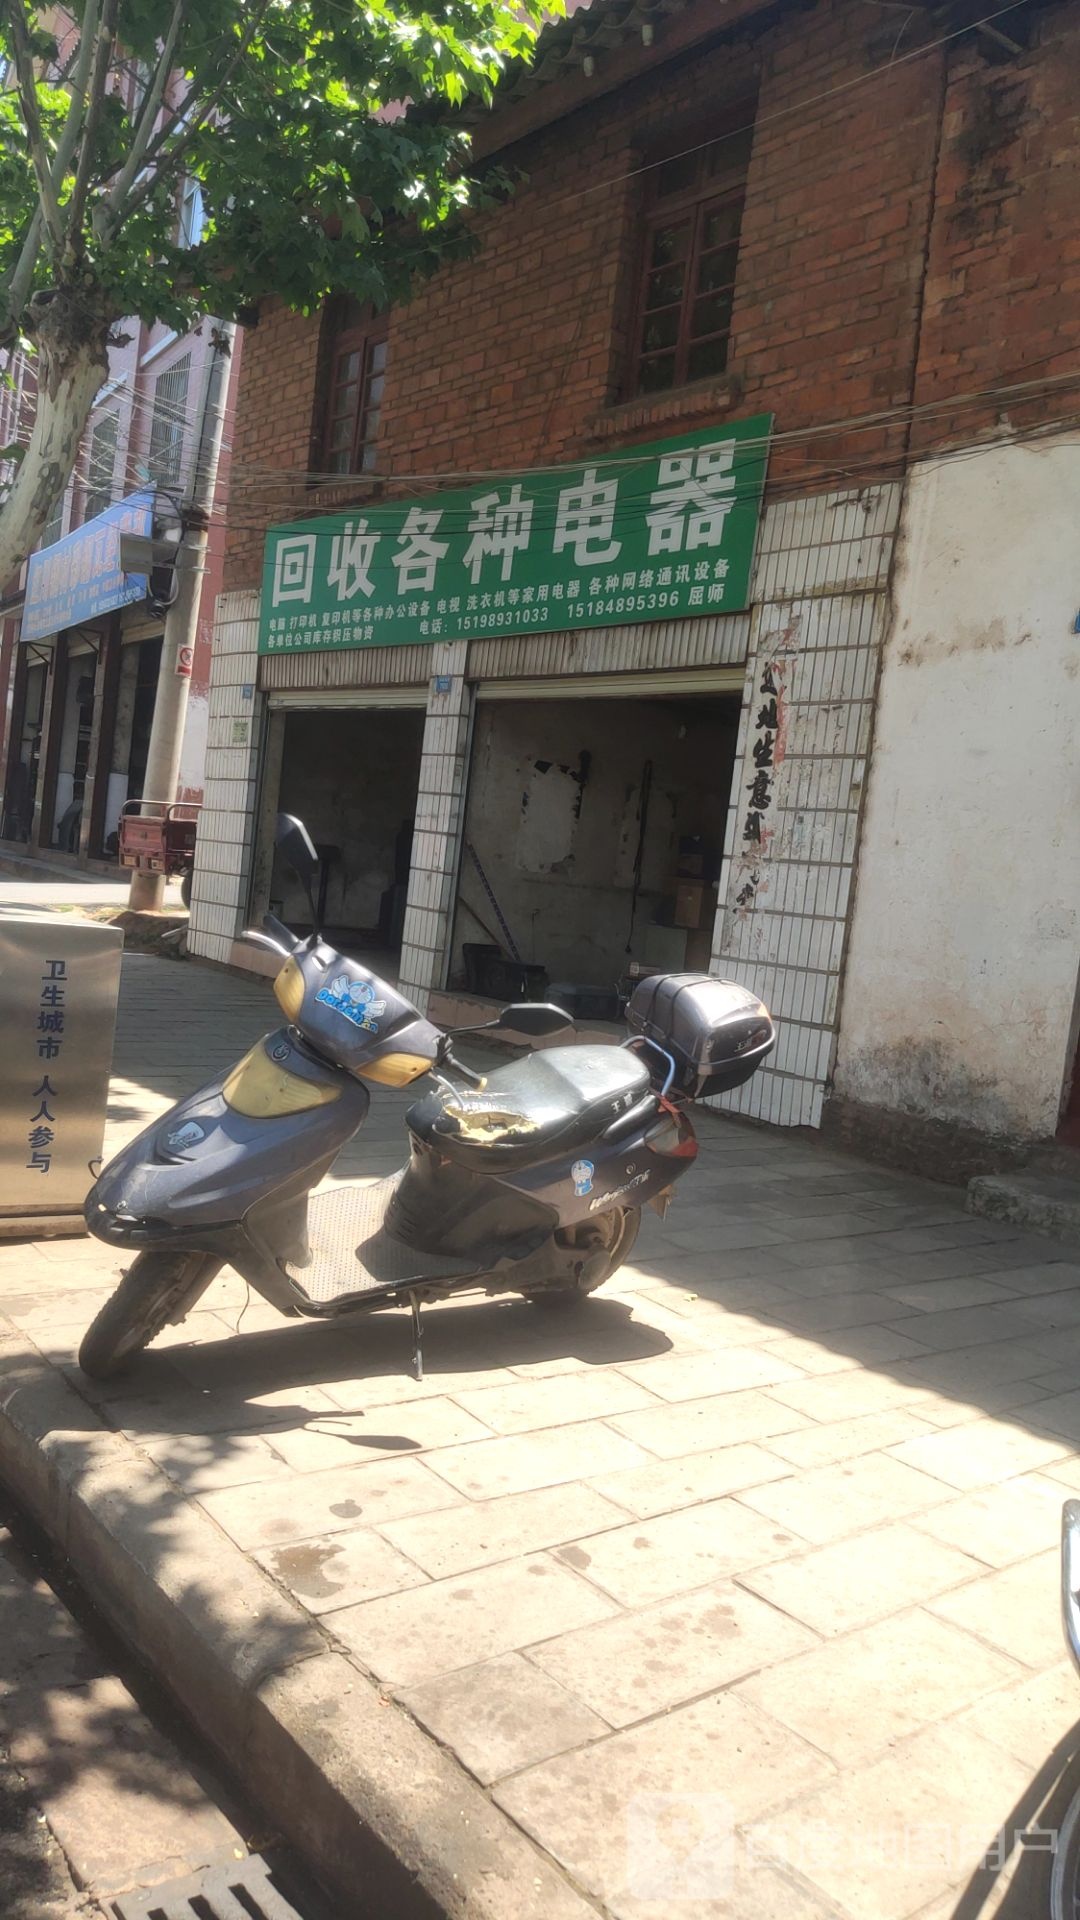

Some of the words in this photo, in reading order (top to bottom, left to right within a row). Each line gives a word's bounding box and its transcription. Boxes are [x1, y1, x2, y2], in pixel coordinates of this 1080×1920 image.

[272, 438, 738, 608] 回收各种电器
[289, 613, 317, 629] 打印机
[436, 596, 460, 614] 电视
[466, 579, 580, 611] 洗衣机等家用电器
[588, 558, 730, 597] 各种网络通讯设备
[456, 607, 549, 631] 15198931033
[567, 591, 679, 619] 15184895396
[687, 583, 725, 606] 屈师
[36, 959, 68, 1059] 卫生城市
[26, 1075, 58, 1174] 人人参与
